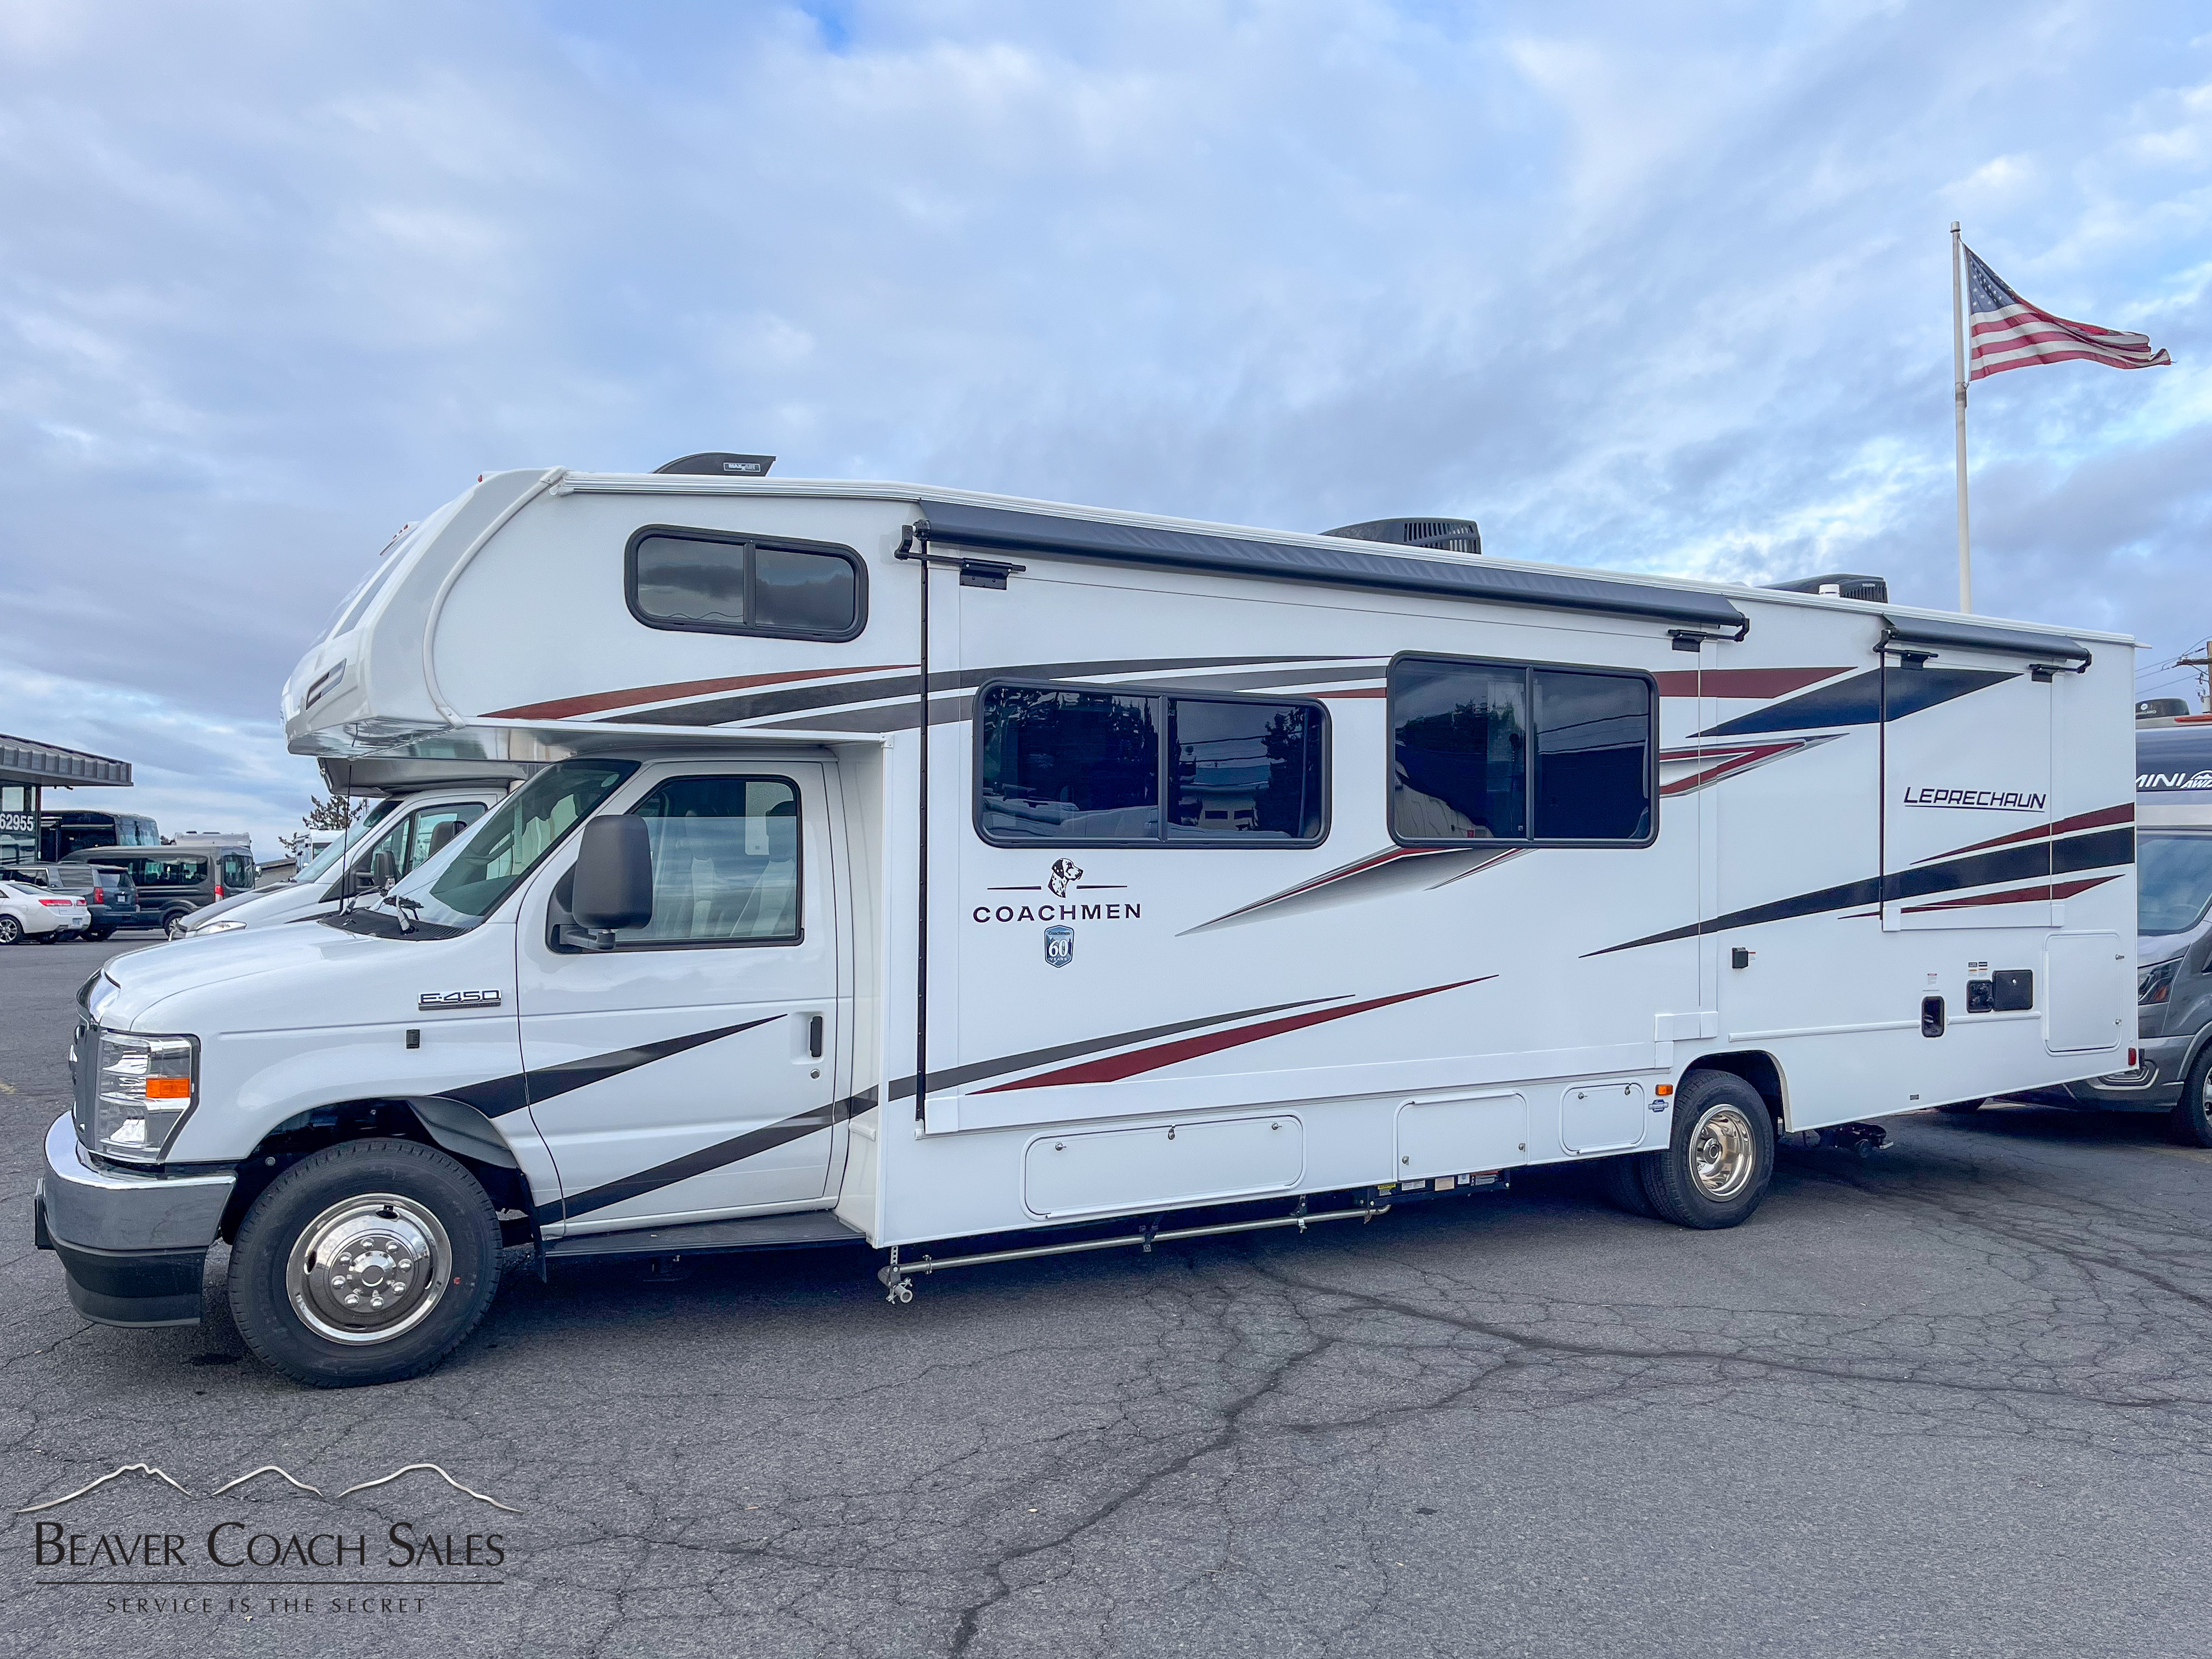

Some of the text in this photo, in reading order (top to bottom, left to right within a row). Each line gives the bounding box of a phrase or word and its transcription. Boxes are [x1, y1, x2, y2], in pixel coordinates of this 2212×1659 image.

[1903, 787, 2047, 810] LEPRECHAUN
[0, 813, 34, 832] 62955
[973, 903, 1141, 923] COACHMEN
[1048, 939, 1069, 957] 60
